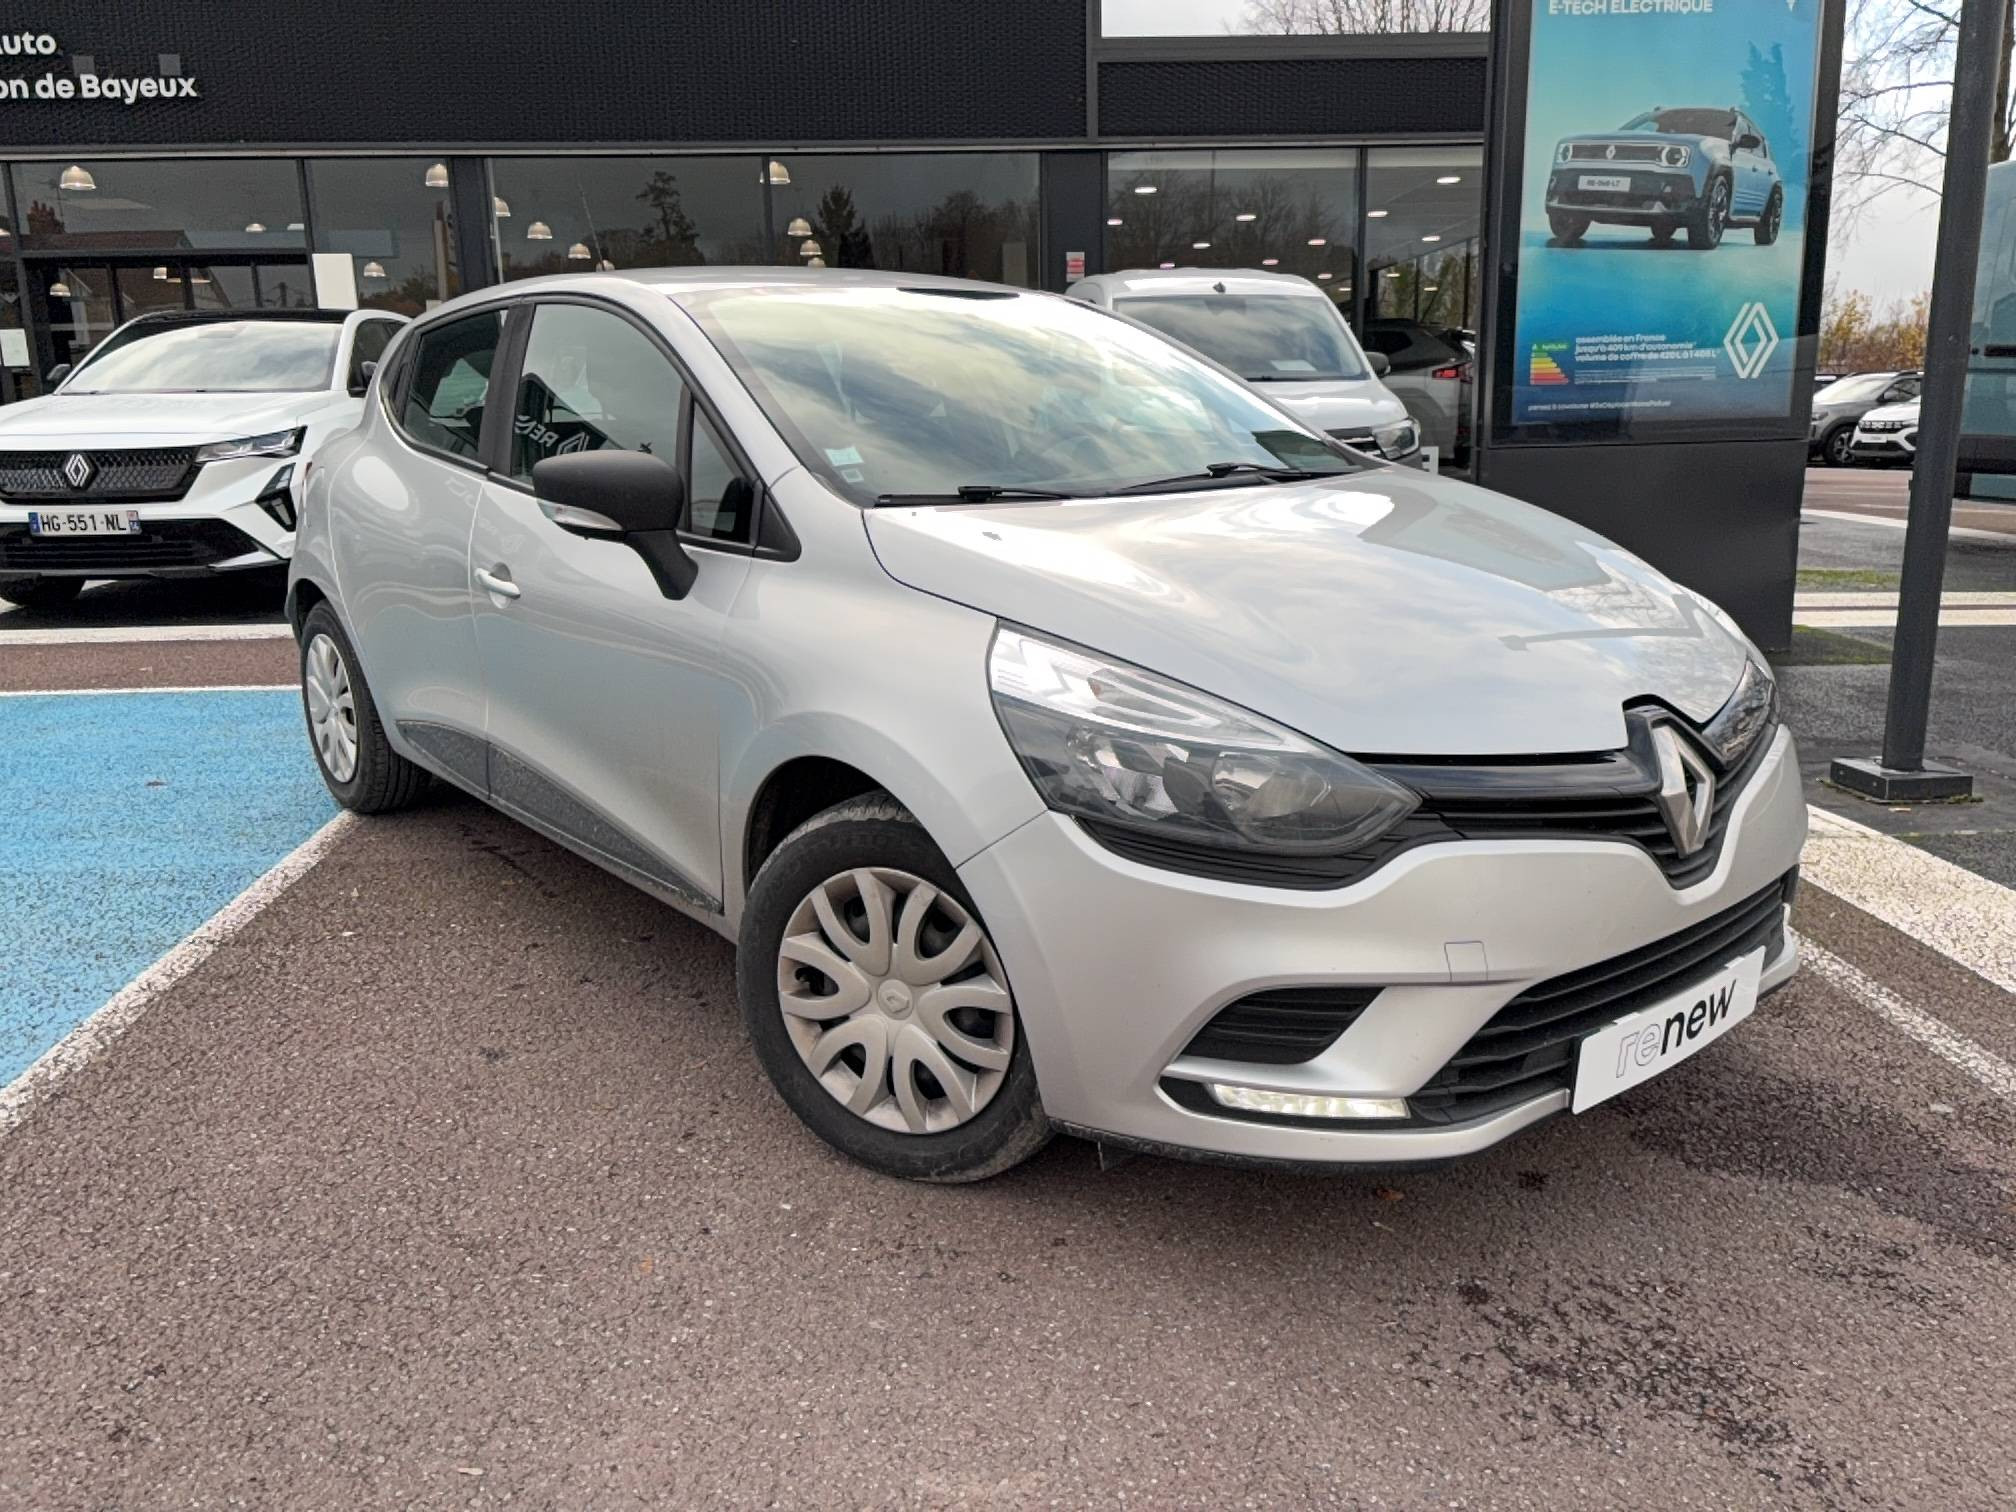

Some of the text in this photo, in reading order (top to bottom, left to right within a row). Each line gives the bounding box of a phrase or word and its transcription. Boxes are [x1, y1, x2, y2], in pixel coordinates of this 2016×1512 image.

[1549, 0, 1606, 15] E-TECH
[0, 31, 57, 55] uto
[35, 72, 75, 99] de
[80, 73, 198, 105] Bayeux
[40, 514, 127, 533] HG-551-NL
[1616, 978, 1737, 1079] renew
